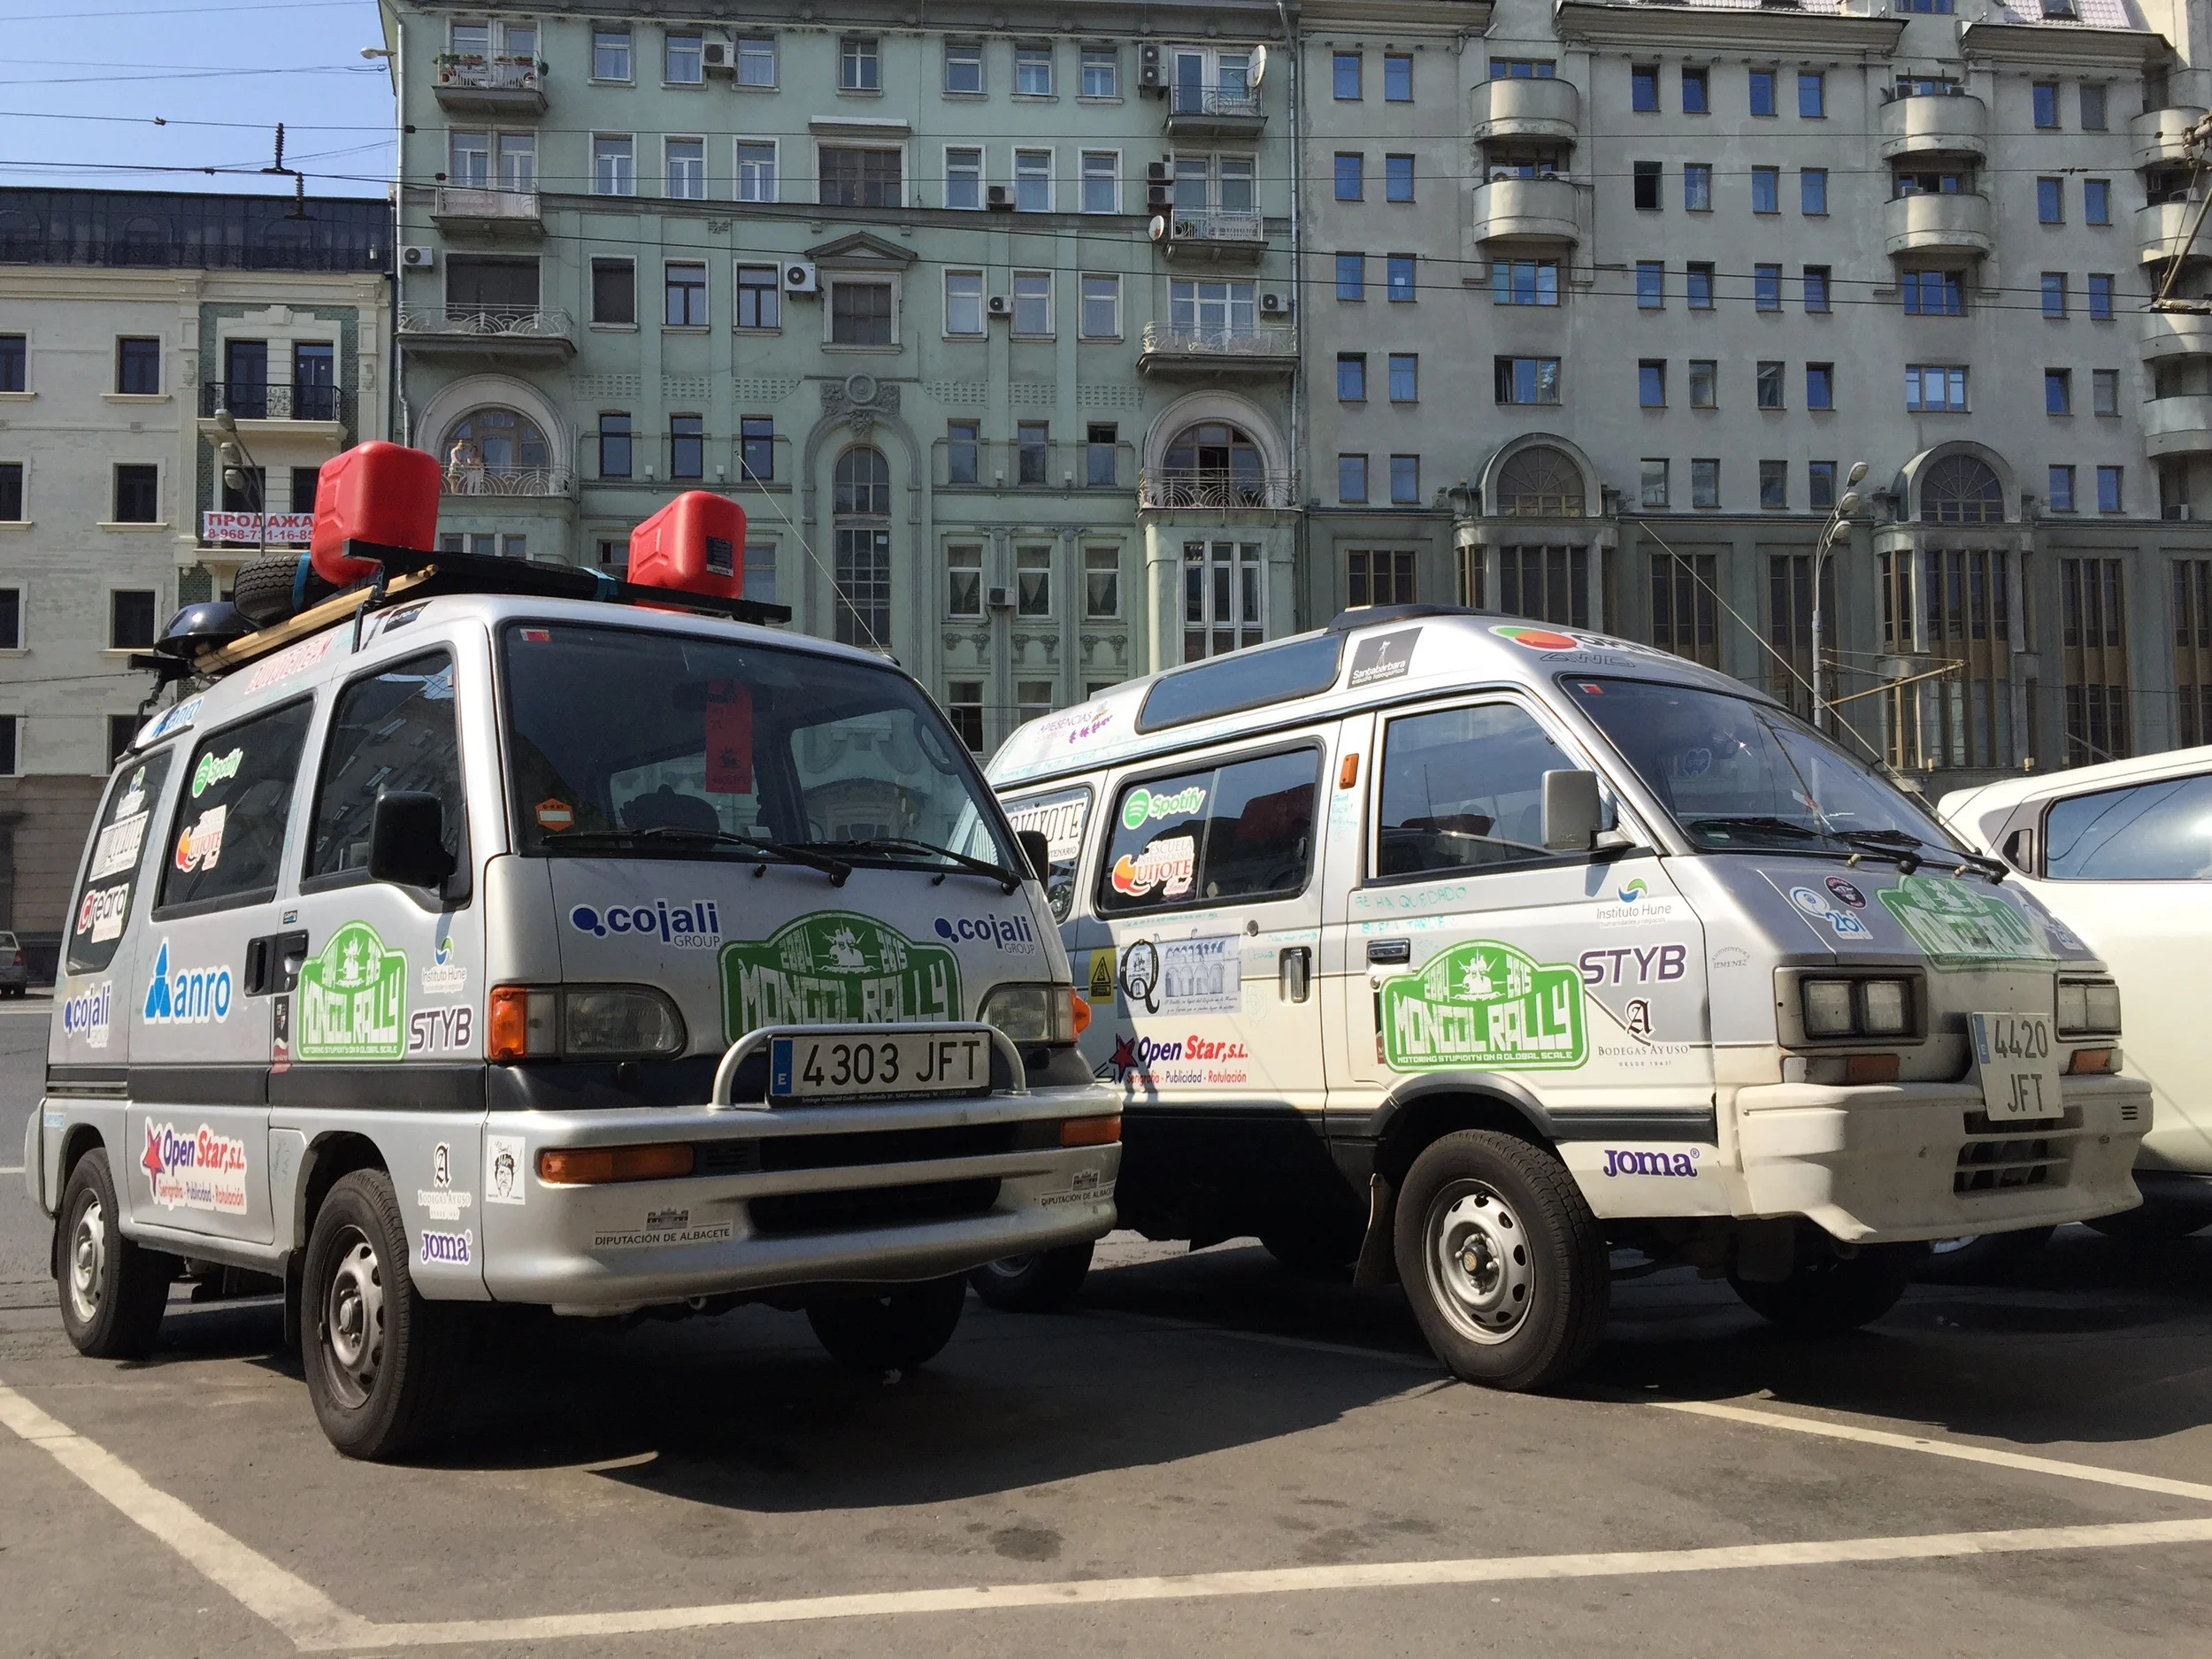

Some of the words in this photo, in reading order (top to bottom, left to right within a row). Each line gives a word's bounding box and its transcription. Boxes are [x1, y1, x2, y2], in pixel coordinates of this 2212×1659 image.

[208, 514, 313, 528] ПРОДАЖА
[209, 529, 313, 540] 8-968-71-16-85
[1151, 788, 1204, 817] Spotify
[1150, 840, 1192, 855] ESCUELA
[607, 902, 718, 942] cojali
[1597, 906, 1639, 919] Instituto
[1642, 904, 1671, 916] Hune
[1600, 918, 1636, 927] humanidades
[674, 935, 720, 948] GROUP
[957, 914, 1033, 949] cojali
[1004, 943, 1035, 955] GROUP
[1579, 944, 1686, 984] STYB
[174, 971, 231, 1018] anro
[354, 967, 400, 1044] RALLY
[862, 959, 949, 1024] RALLY
[73, 985, 110, 1039] cojali
[1394, 991, 1486, 1055] MONGOL
[1487, 979, 1573, 1051] RALLY
[410, 1008, 472, 1050] STYB
[1995, 1020, 2048, 1058] 4420
[803, 1042, 899, 1087] 4303
[916, 1041, 980, 1082] JFT
[1138, 1036, 1182, 1069] Open
[1438, 1054, 1482, 1063] STUPIDITY
[1598, 1046, 1646, 1056] BODEGAS
[1651, 1045, 1688, 1055] AYUSO
[778, 1073, 787, 1085] E
[1165, 1069, 1202, 1084] Publicidad
[1208, 1070, 1247, 1084] Rotulación
[2007, 1073, 2042, 1112] JFT
[164, 1129, 195, 1176] Open
[1041, 1194, 1080, 1205] DIPUTACIÓN
[1083, 1192, 1091, 1201] DE
[595, 1233, 660, 1245] DIPUTACIÓN
[664, 1233, 677, 1242] DE
[680, 1228, 730, 1240] ALBACETE
